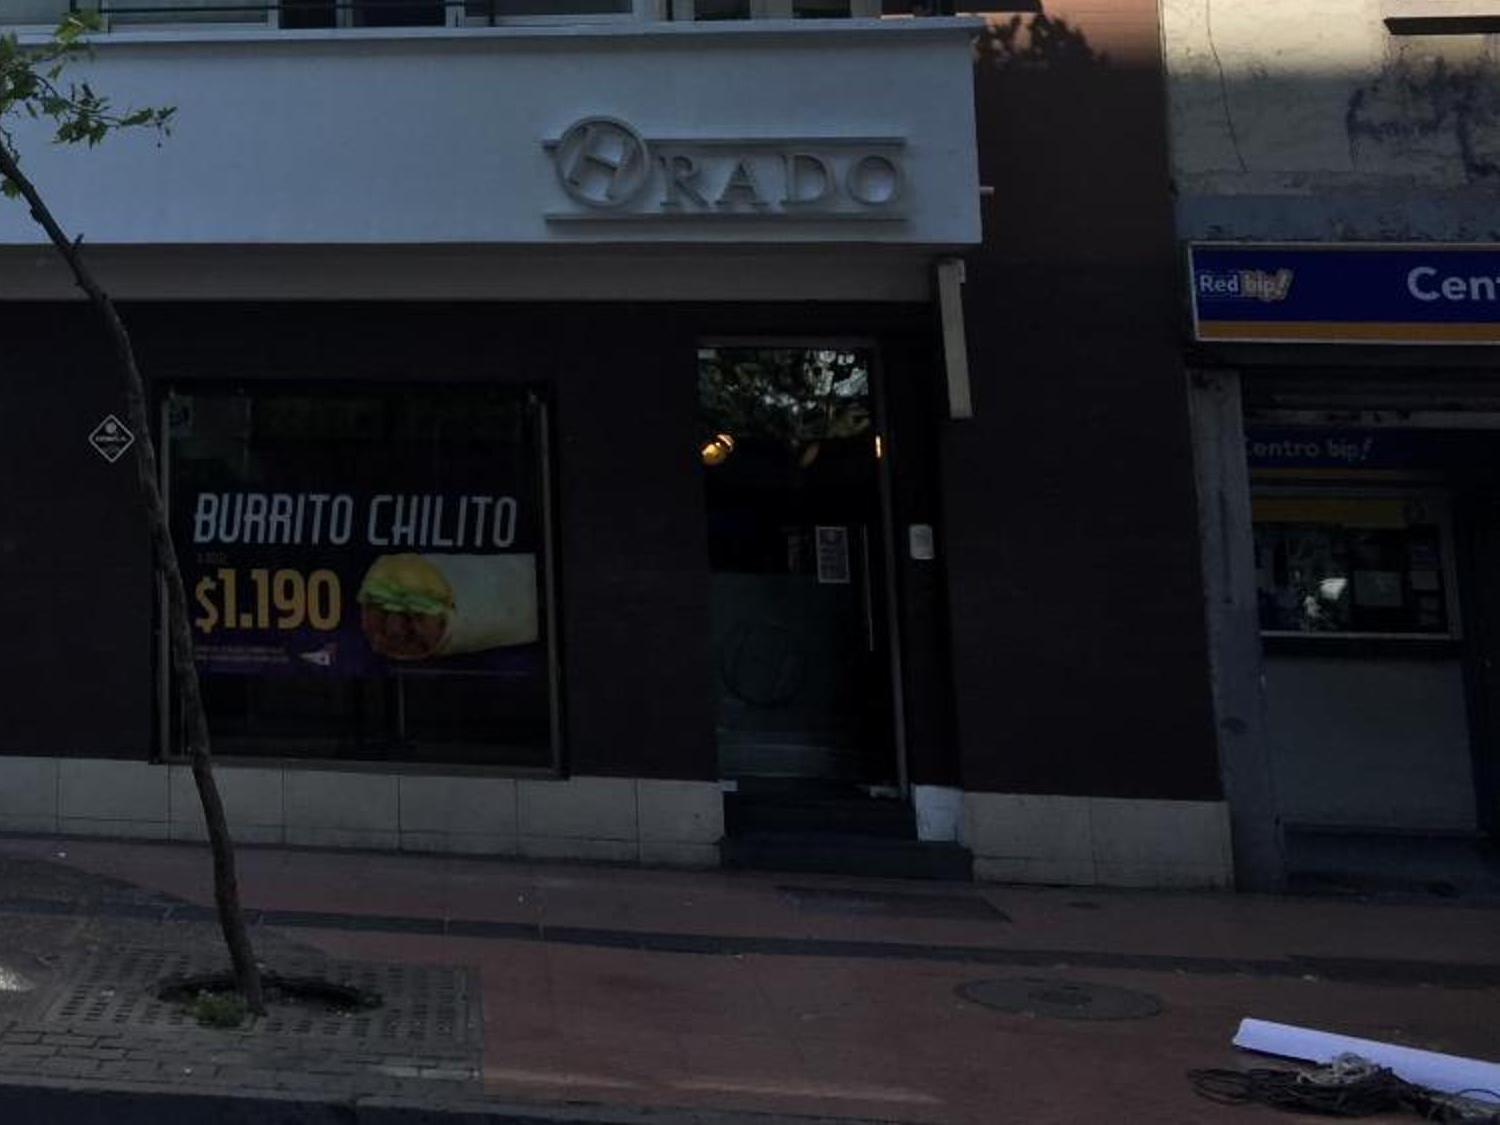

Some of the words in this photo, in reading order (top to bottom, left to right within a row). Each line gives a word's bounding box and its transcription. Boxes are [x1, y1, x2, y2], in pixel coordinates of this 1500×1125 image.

[1199, 275, 1239, 293] Red
[1406, 266, 1500, 301] Cen
[193, 492, 354, 546] BURRITO
[366, 495, 518, 549] CHILITO
[195, 568, 342, 634] $1.190
